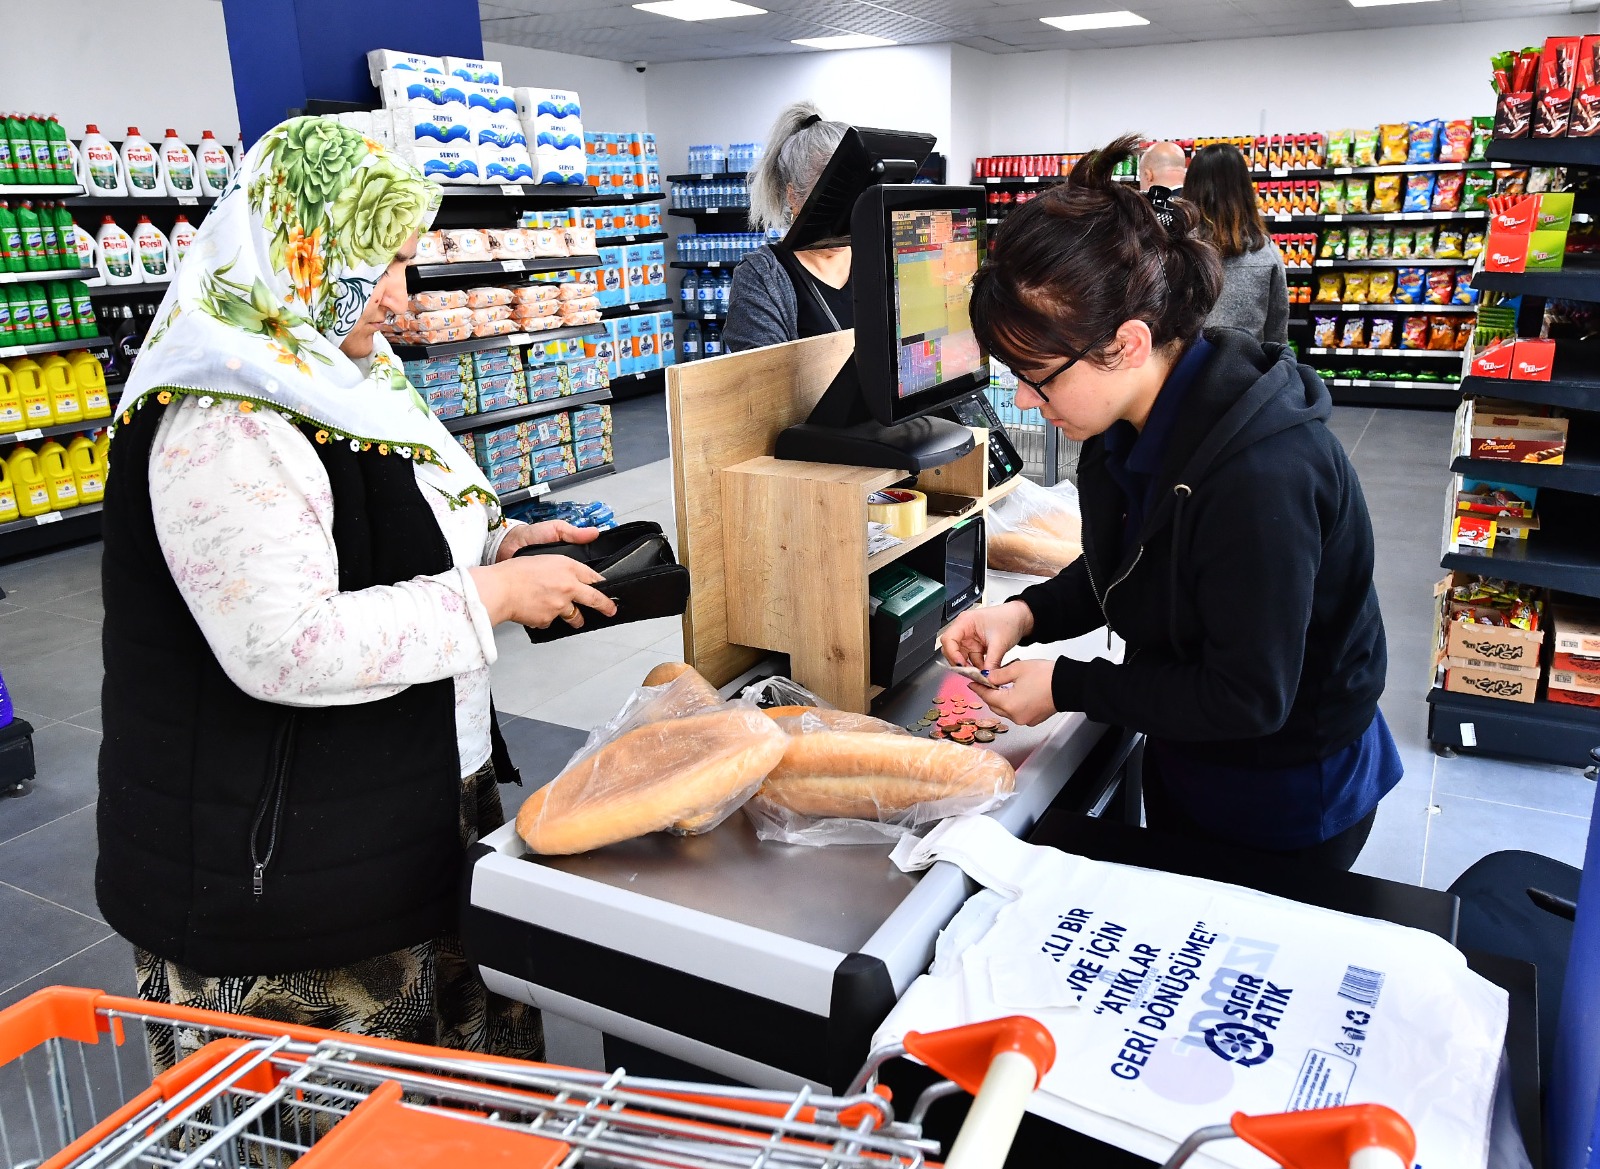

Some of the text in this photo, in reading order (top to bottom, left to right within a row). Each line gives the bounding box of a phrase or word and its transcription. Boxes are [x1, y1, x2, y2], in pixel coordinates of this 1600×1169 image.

[88, 151, 113, 161] Persil
[127, 152, 153, 162] Persil
[167, 153, 189, 163] Persil
[204, 155, 226, 164] Persil
[103, 241, 128, 250] Persil
[140, 239, 163, 249] Persil
[1478, 441, 1516, 451] Karamela
[1475, 641, 1524, 660] CANGA
[1474, 677, 1523, 696] CANGA
[1057, 907, 1094, 933] BİR
[1066, 921, 1128, 1002] VRE İÇİN
[1223, 974, 1264, 1021] SIFIR
[1251, 981, 1294, 1030] ATIK
[1110, 1028, 1159, 1081] GERİ
